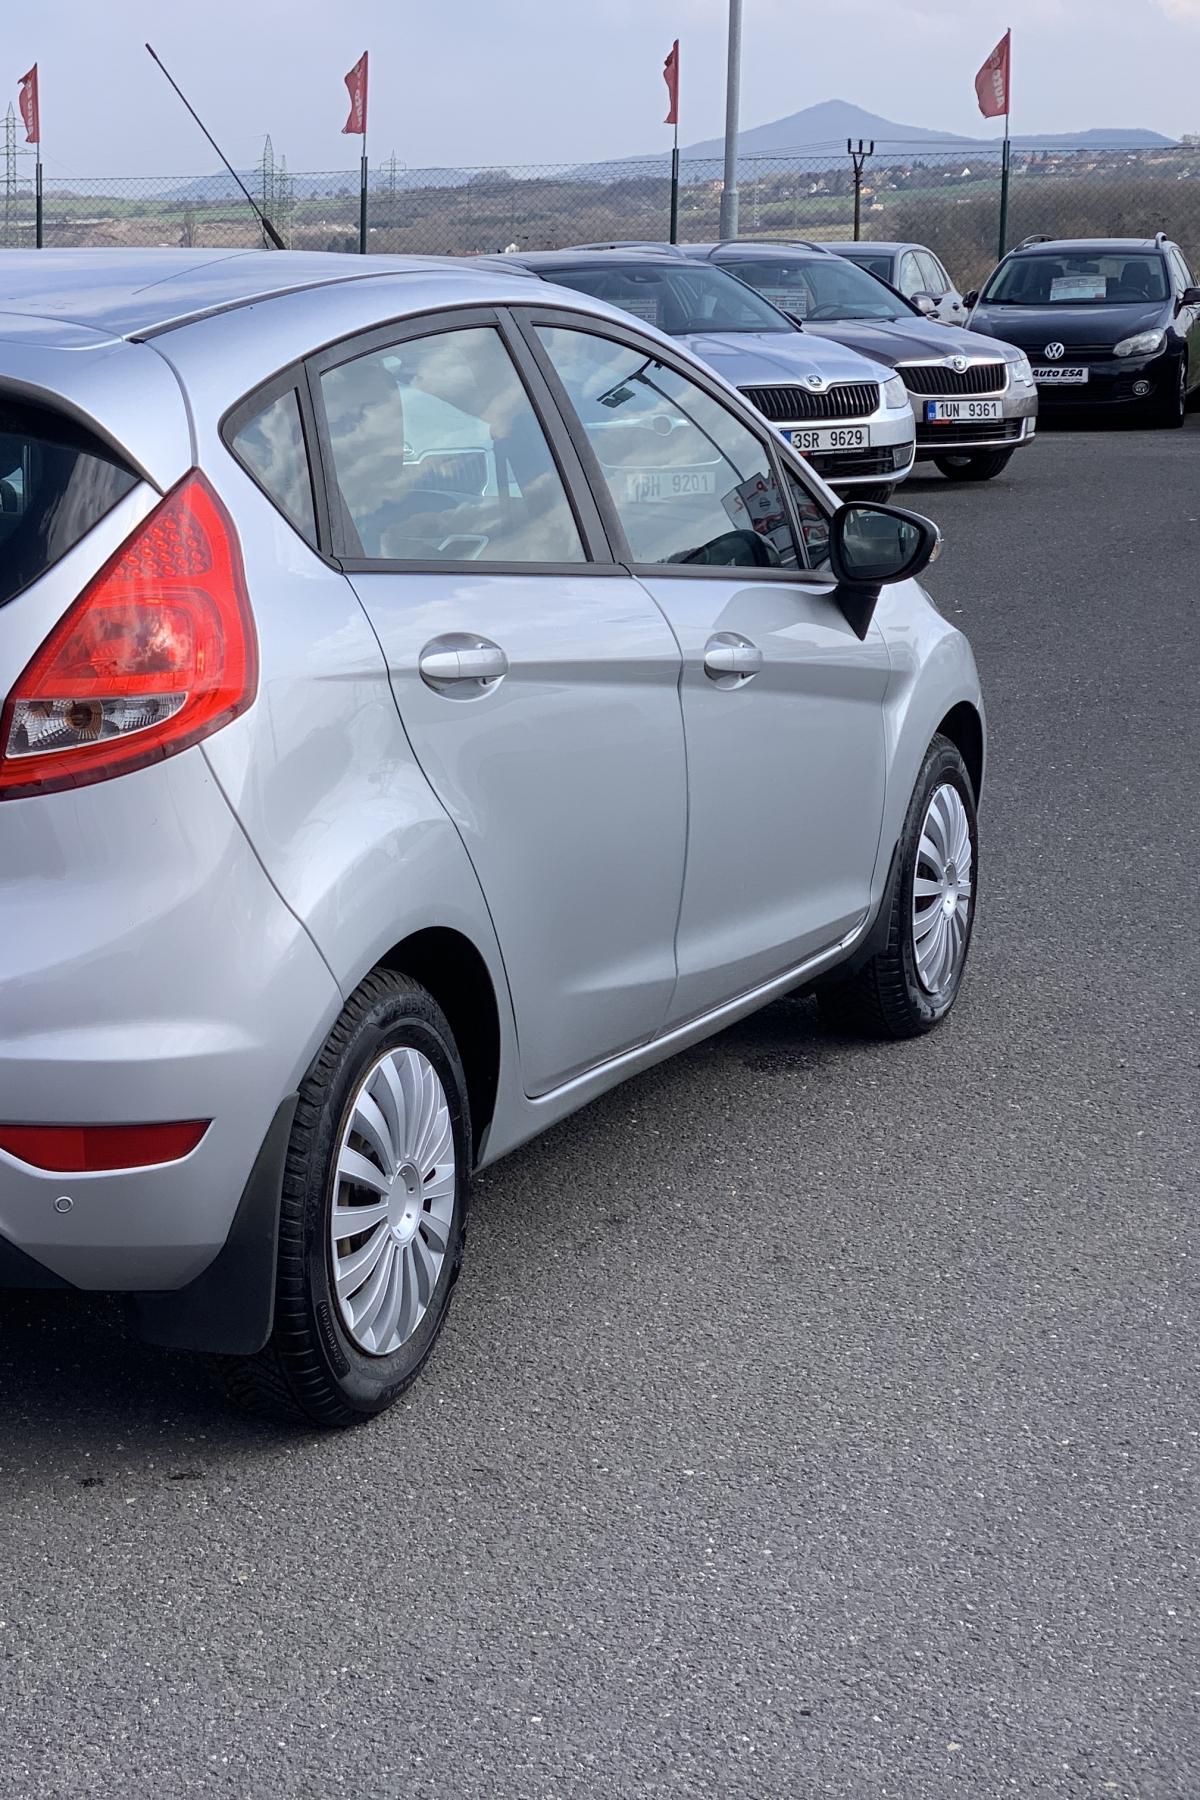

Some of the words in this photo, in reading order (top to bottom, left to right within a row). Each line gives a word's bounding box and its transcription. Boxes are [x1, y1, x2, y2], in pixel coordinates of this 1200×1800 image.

[1032, 369, 1060, 377] Auto
[1061, 369, 1083, 377] ESA
[939, 403, 960, 418] 1UN
[968, 402, 997, 417] 9361
[793, 432, 820, 449] 3SR
[830, 430, 863, 447] 9629
[672, 474, 709, 493] 9201
